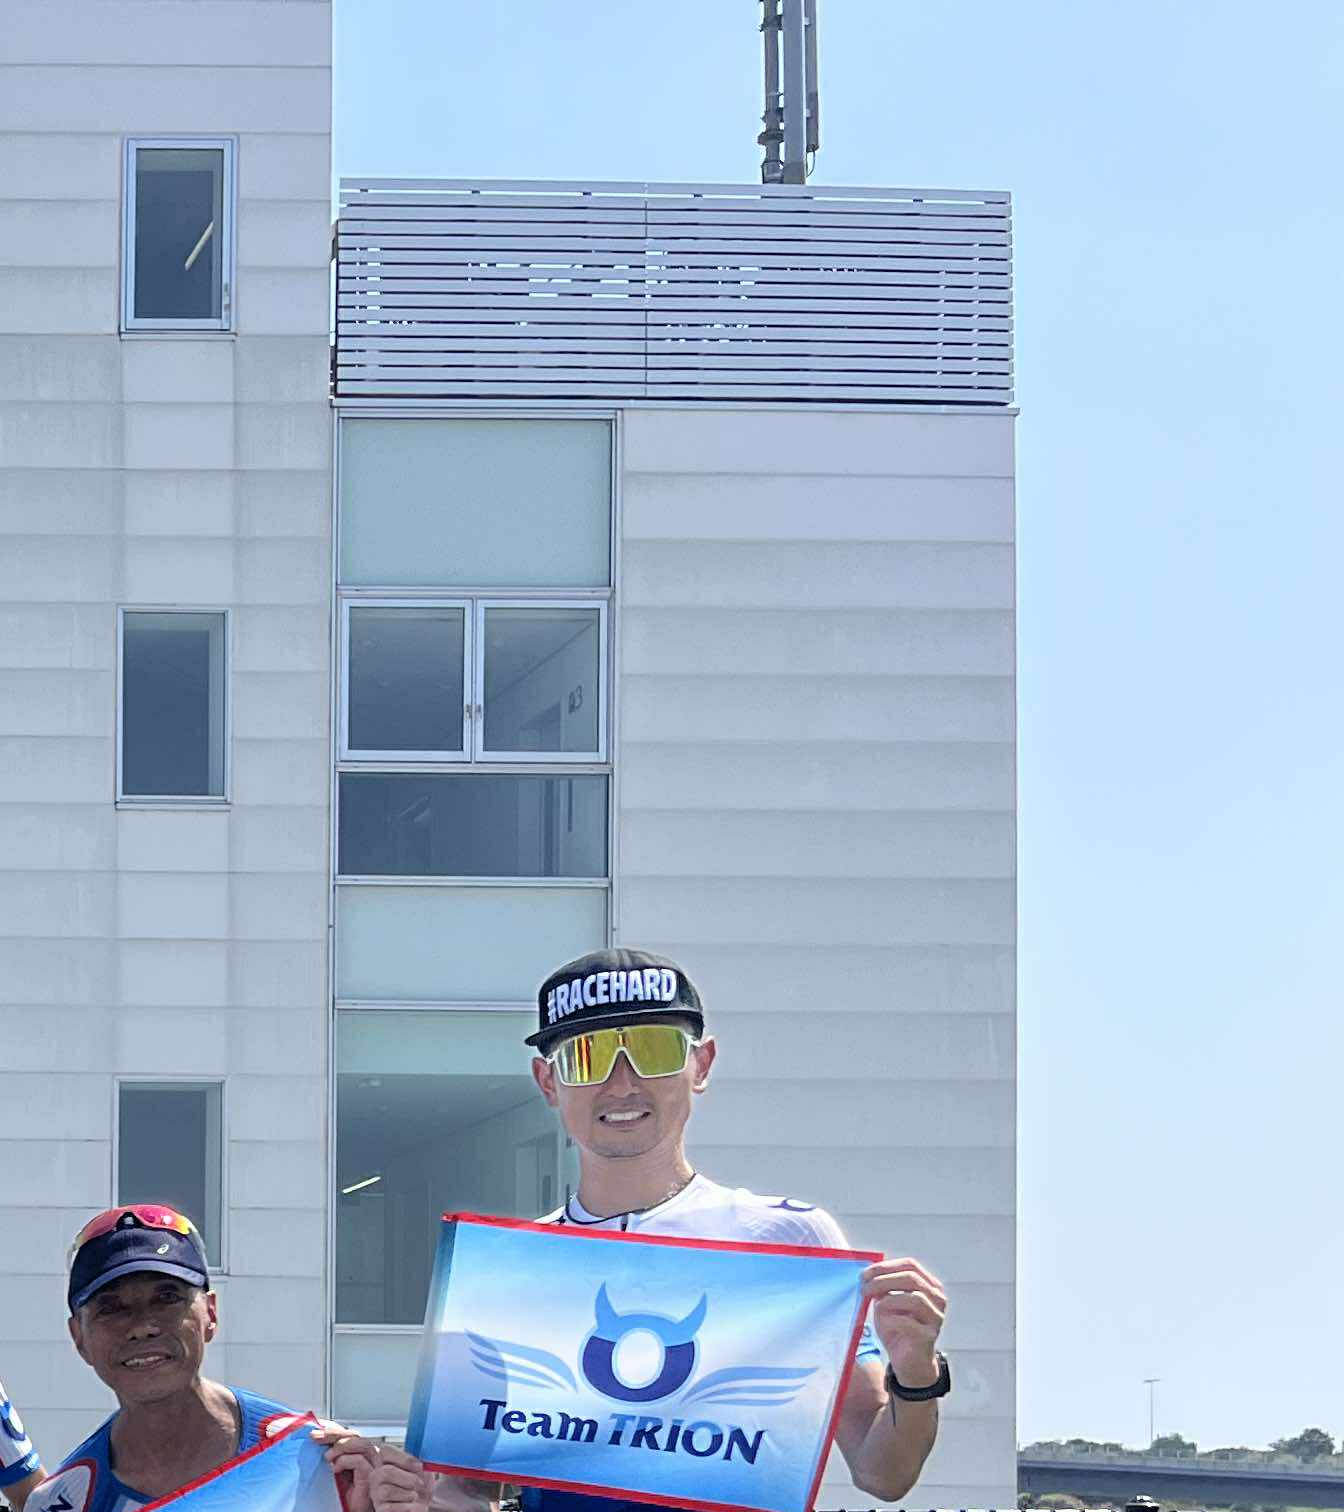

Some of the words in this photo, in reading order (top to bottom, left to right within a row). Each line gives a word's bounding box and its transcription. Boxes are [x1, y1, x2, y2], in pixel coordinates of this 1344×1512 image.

[547, 968, 677, 1024] #RACEHARD
[480, 1399, 597, 1444] Team
[609, 1411, 768, 1466] TRION
